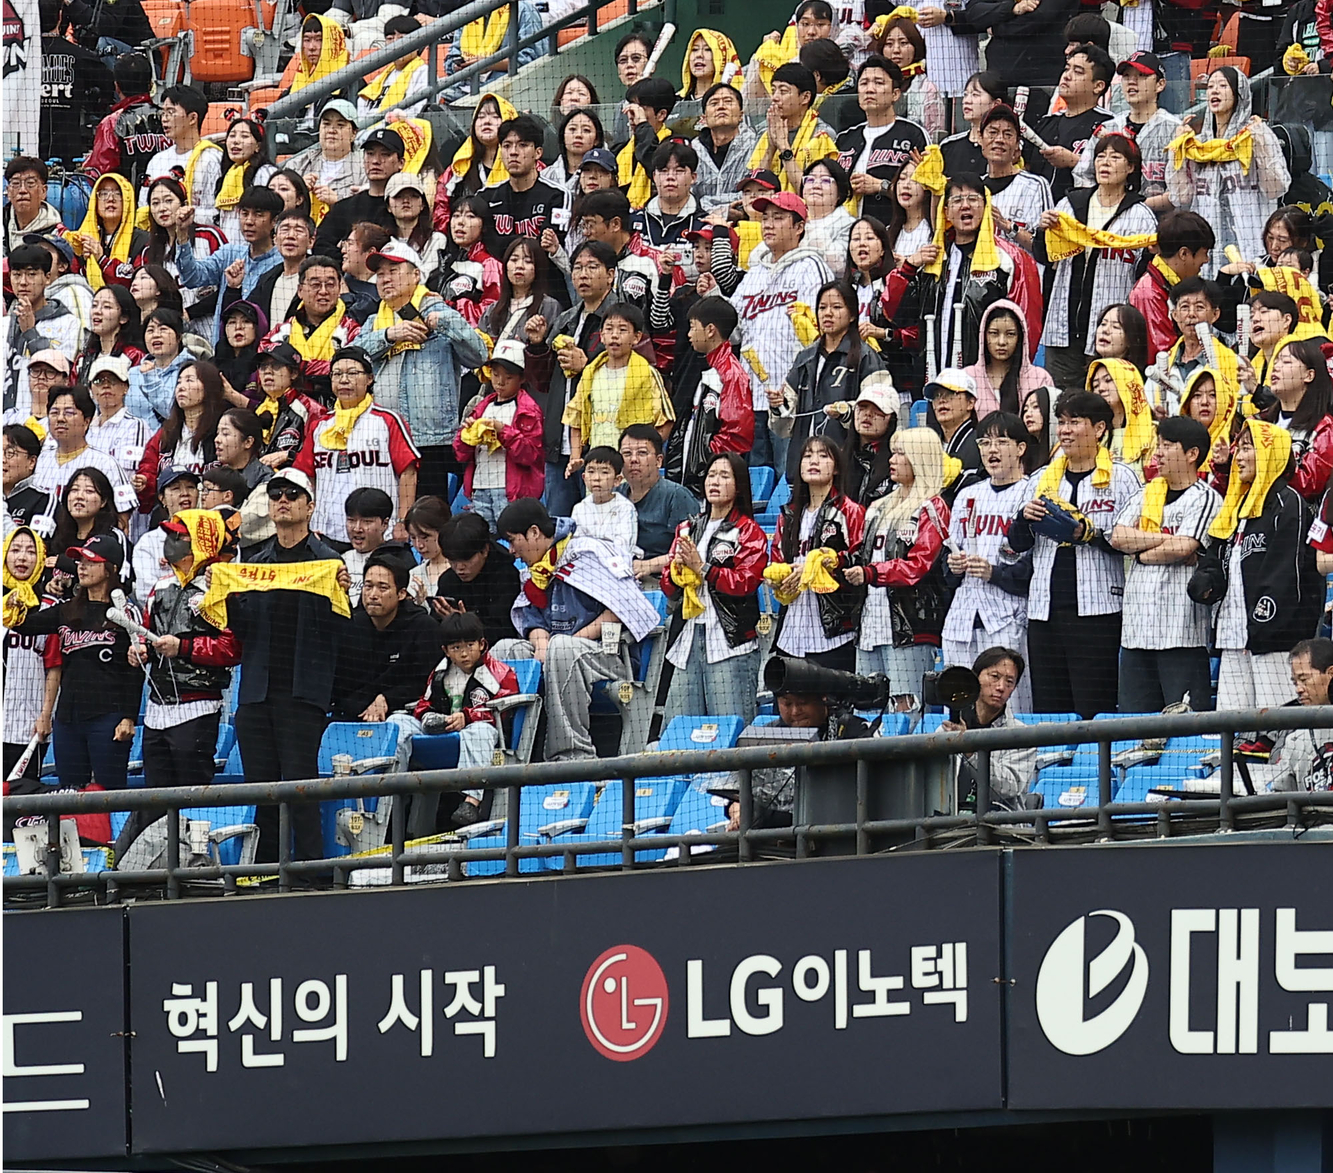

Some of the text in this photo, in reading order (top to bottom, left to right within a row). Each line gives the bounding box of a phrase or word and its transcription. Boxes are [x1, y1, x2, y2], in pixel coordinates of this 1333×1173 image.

[124, 134, 174, 155] TWIN
[892, 138, 911, 151] LG
[531, 204, 545, 215] LG
[782, 278, 797, 289] LG
[743, 290, 799, 321] TWINS
[12, 507, 27, 518] LG
[1170, 511, 1184, 521] LG
[98, 649, 113, 663] C
[686, 941, 968, 1040] LG이노텍
[162, 966, 507, 1071] 혁신의 시작
